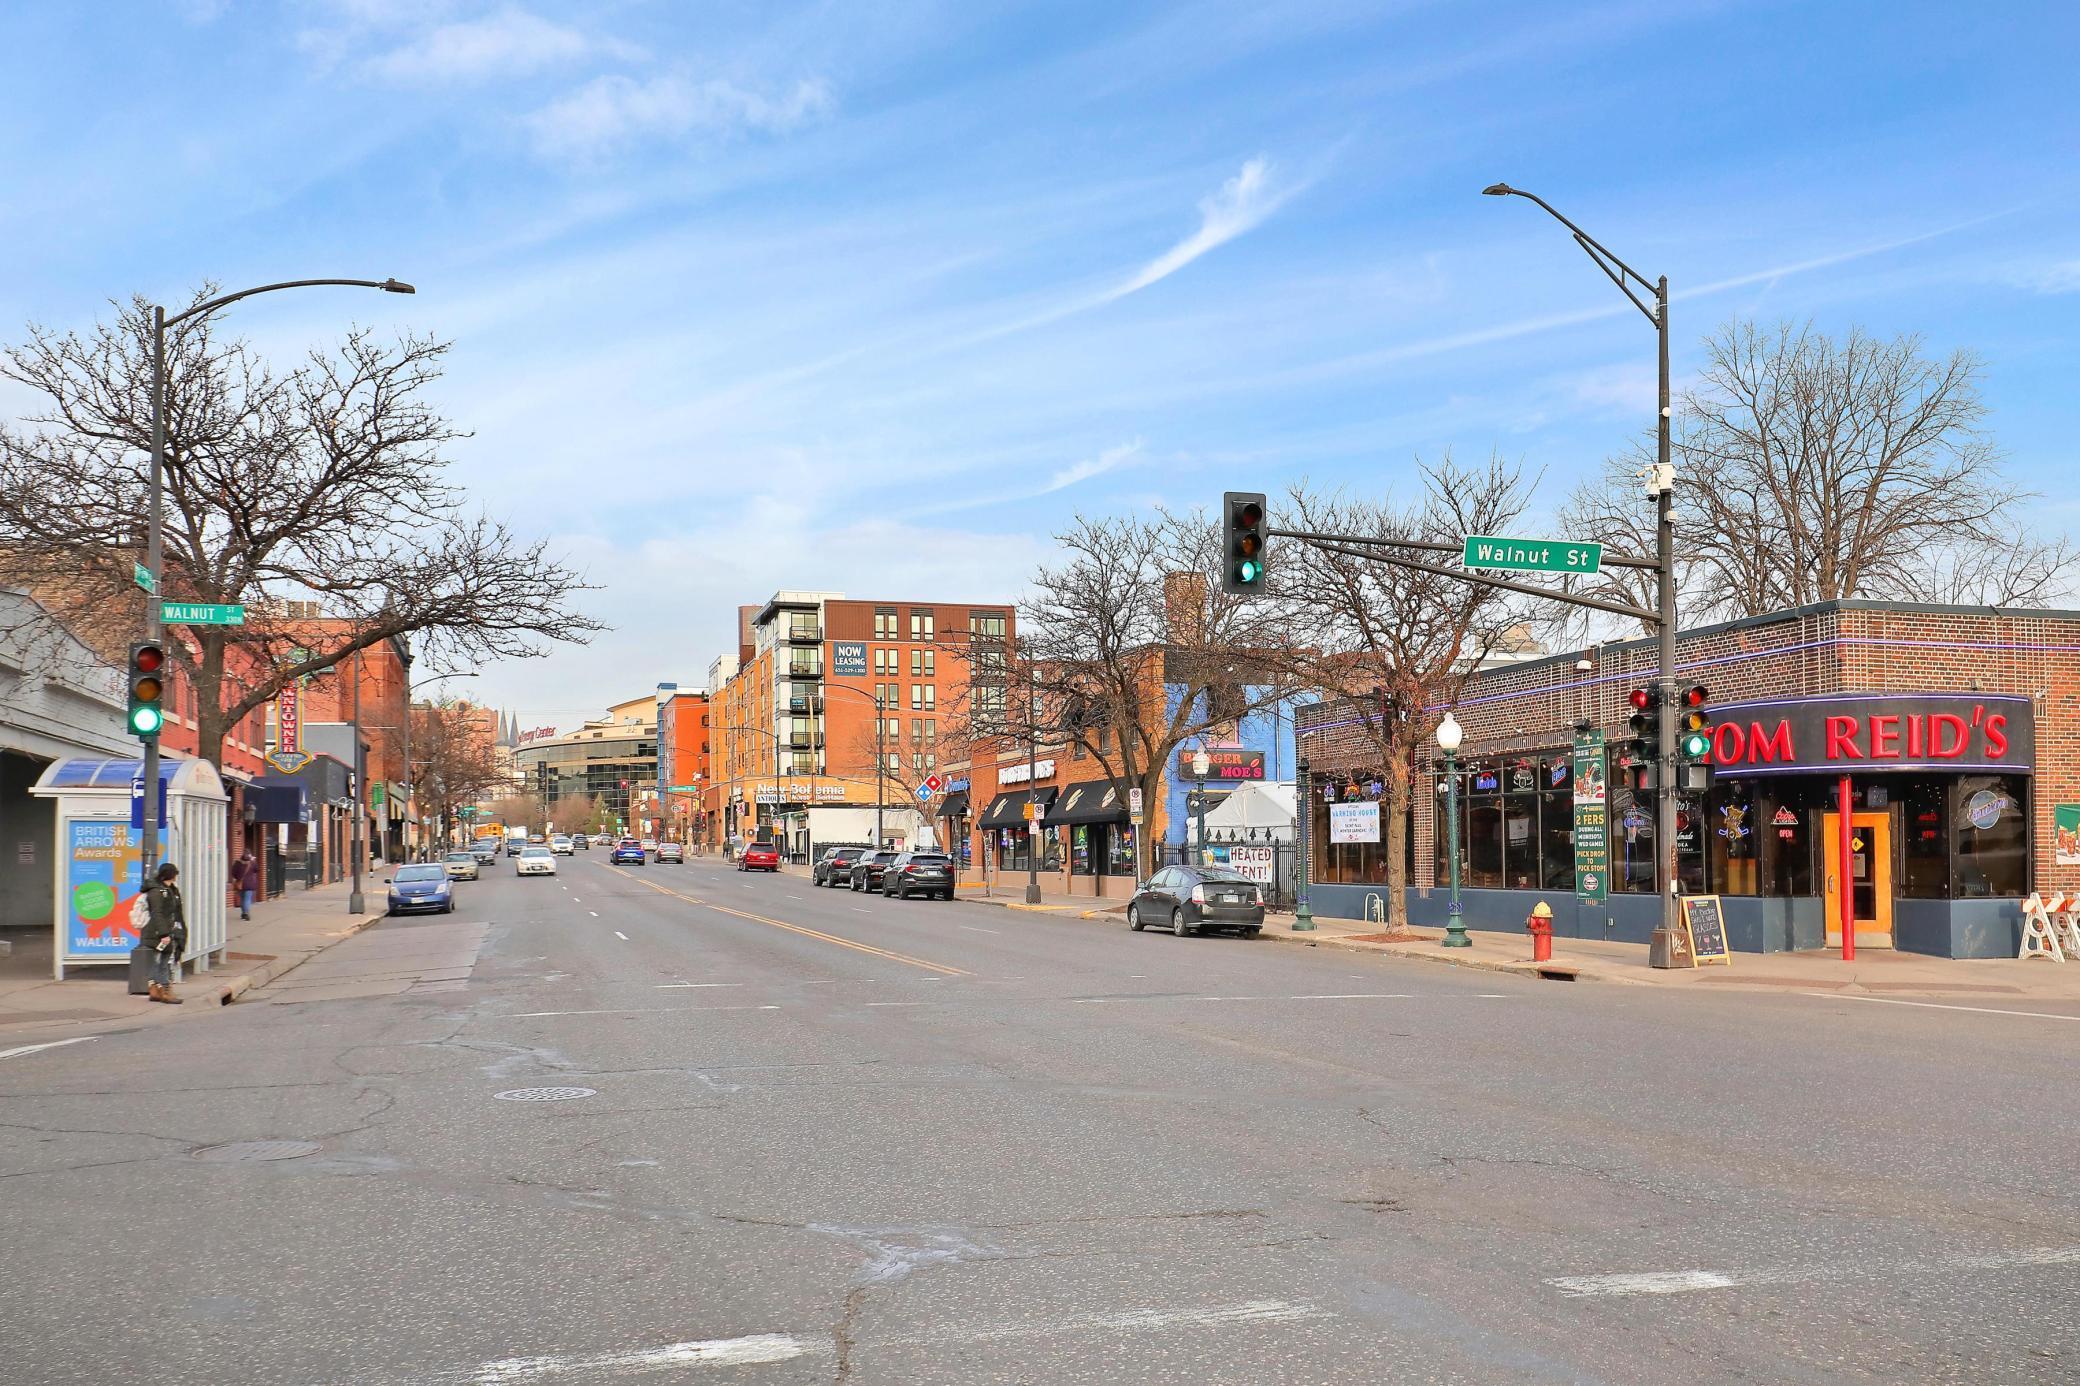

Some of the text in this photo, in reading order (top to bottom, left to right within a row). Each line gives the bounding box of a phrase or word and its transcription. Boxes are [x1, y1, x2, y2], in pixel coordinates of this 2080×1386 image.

[1477, 544, 1589, 567] Walnut St
[164, 606, 216, 620] WALNUT
[838, 646, 862, 657] NOW
[835, 657, 866, 666] LEASING
[281, 679, 297, 754] WNTOWNER
[1826, 705, 2009, 760] REID'S
[757, 783, 787, 795] New
[1575, 814, 1605, 825] 2 FERS
[75, 826, 127, 836] BRITISH
[1779, 829, 1793, 838] OPEN
[75, 837, 135, 847] ARROWS
[75, 847, 122, 858] Awards
[1230, 847, 1272, 863] HEATED
[1576, 850, 1590, 858] PUCK
[1234, 865, 1267, 880] TENT!
[75, 937, 128, 947] WALKER
